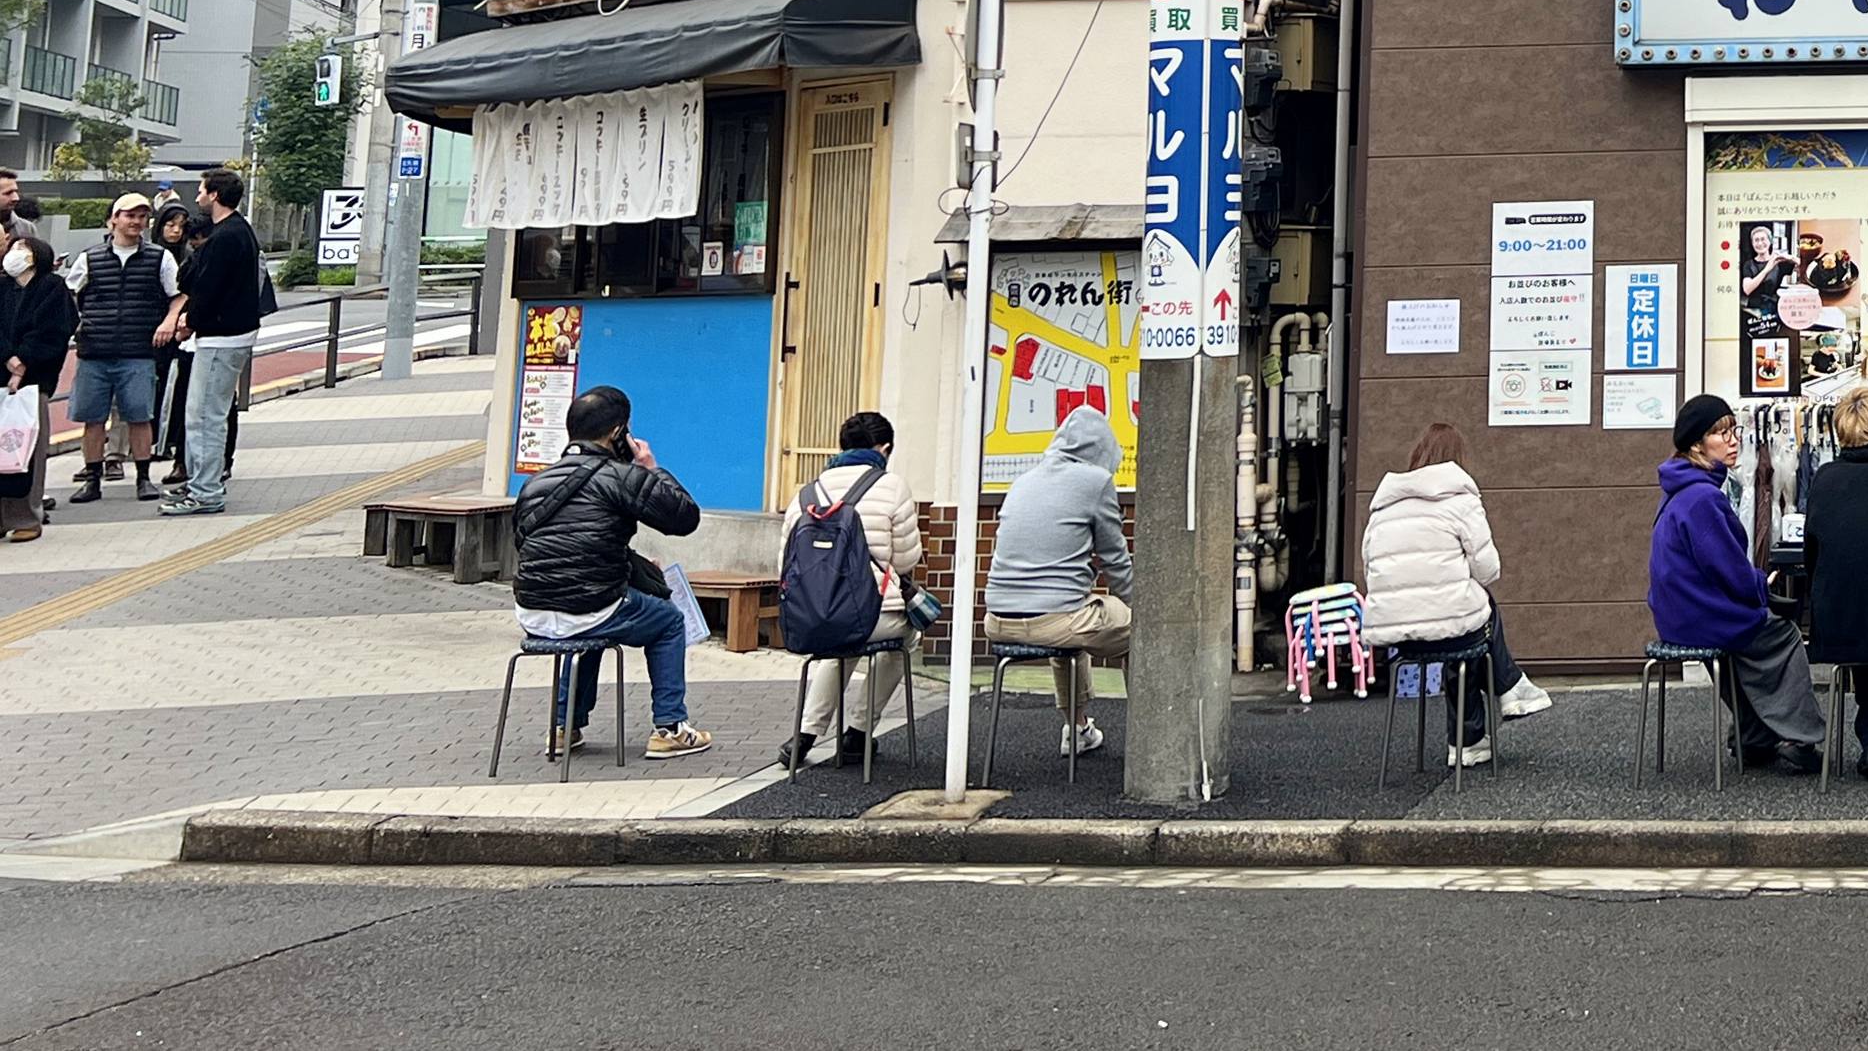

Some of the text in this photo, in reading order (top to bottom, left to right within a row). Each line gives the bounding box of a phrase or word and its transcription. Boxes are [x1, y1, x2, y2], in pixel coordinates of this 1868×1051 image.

[1630, 273, 1659, 284] 日曜日
[1028, 280, 1133, 308] のれん街
[1152, 301, 1193, 316] この先
[1632, 289, 1655, 365] 定休日
